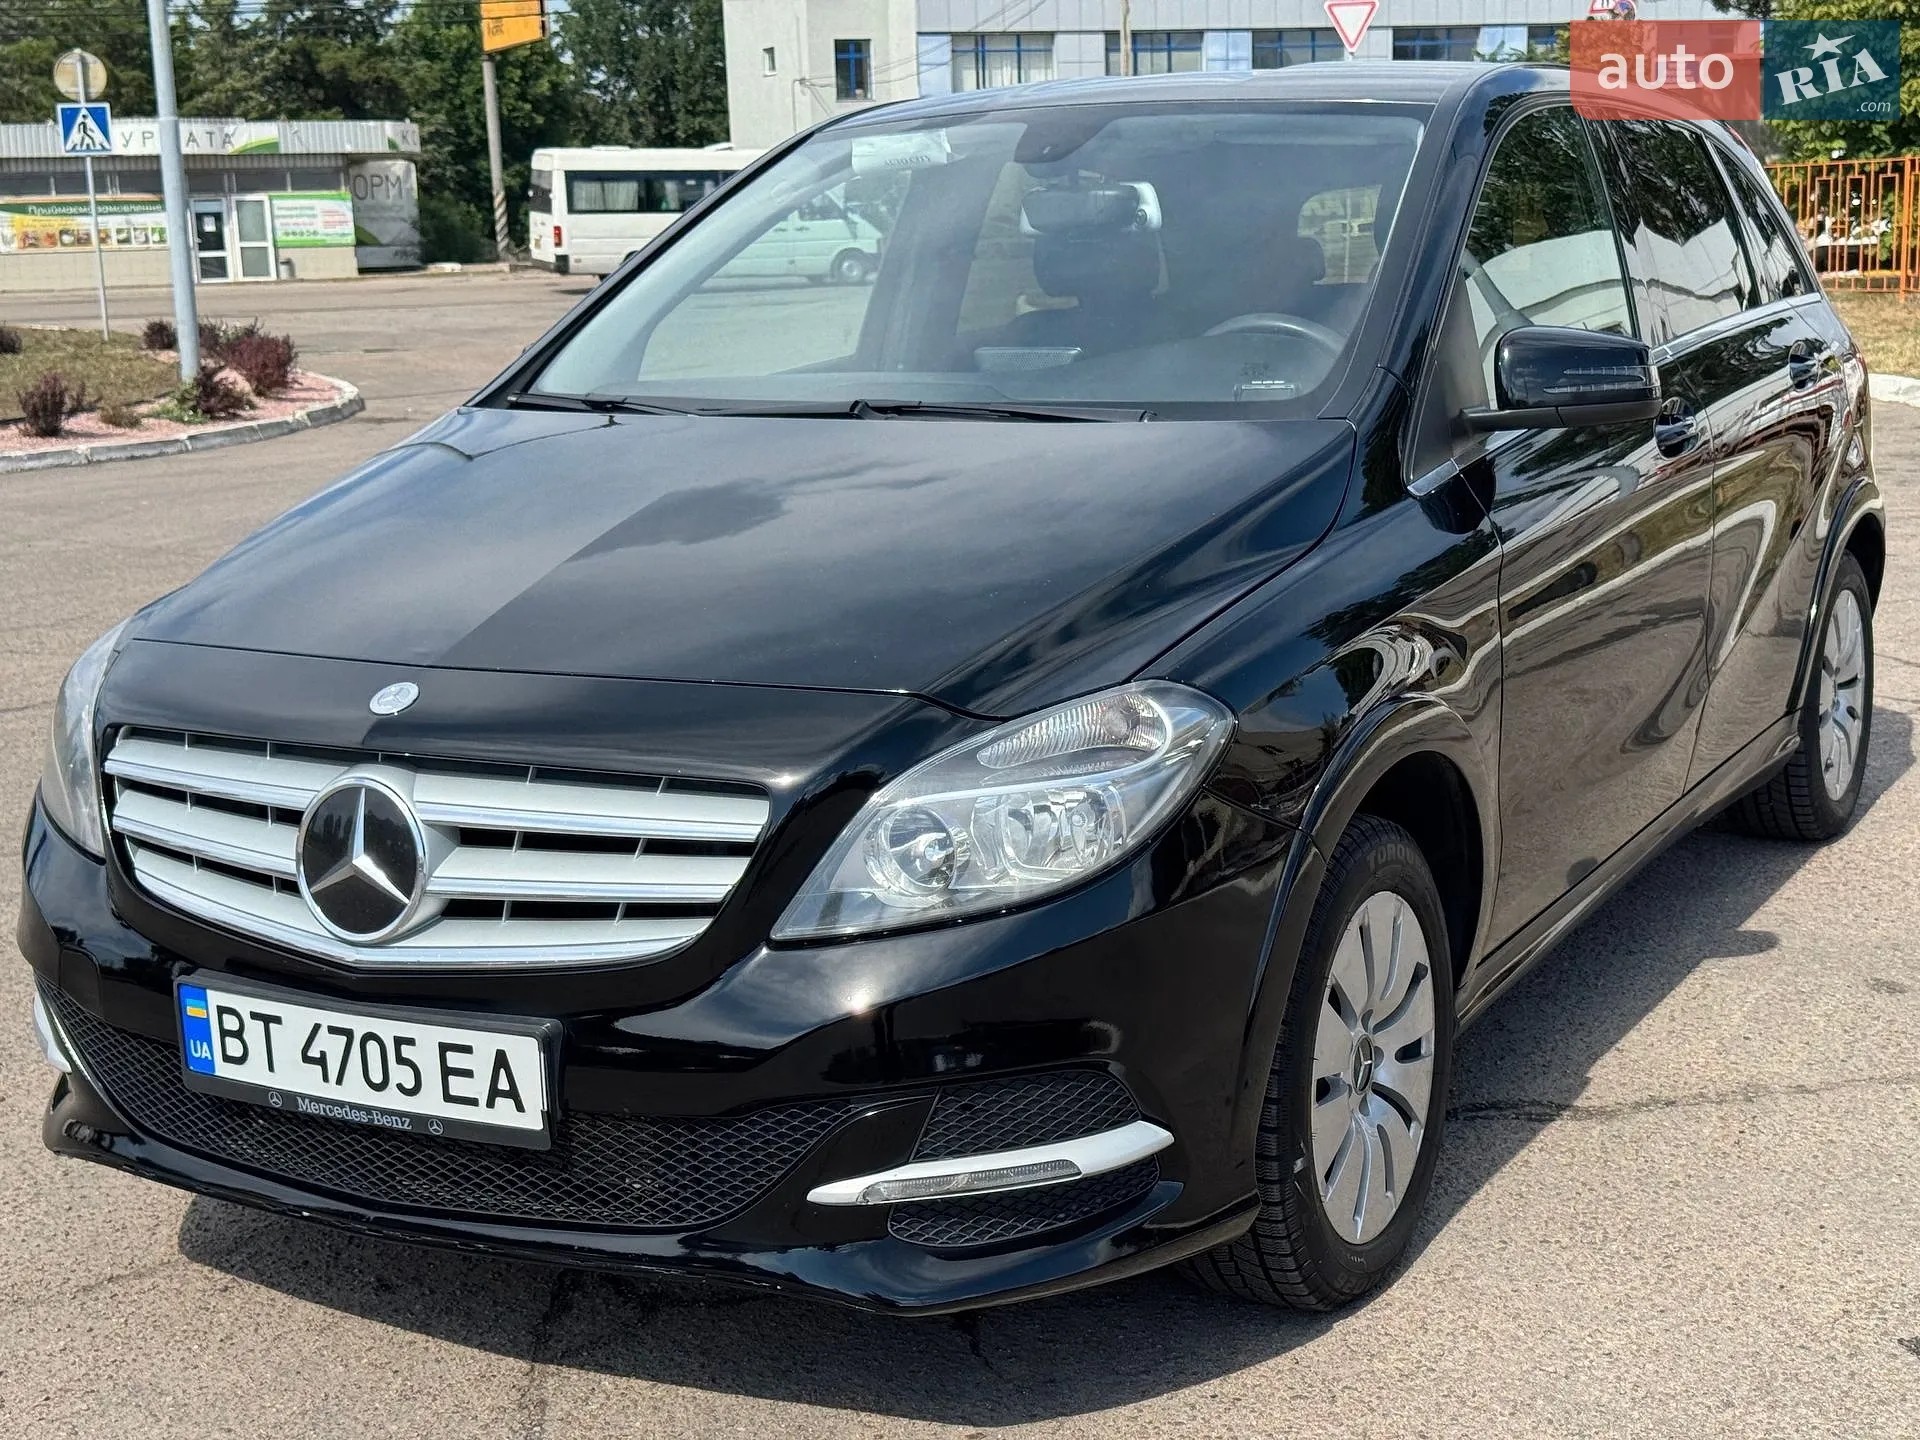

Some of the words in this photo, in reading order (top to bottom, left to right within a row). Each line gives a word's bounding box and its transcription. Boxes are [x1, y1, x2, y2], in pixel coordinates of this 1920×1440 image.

[190, 1039, 212, 1061] UA
[216, 1004, 283, 1073] BT
[301, 1022, 423, 1097] 4705
[438, 1041, 527, 1114] EA
[297, 1096, 413, 1130] Mercedes-Benz
